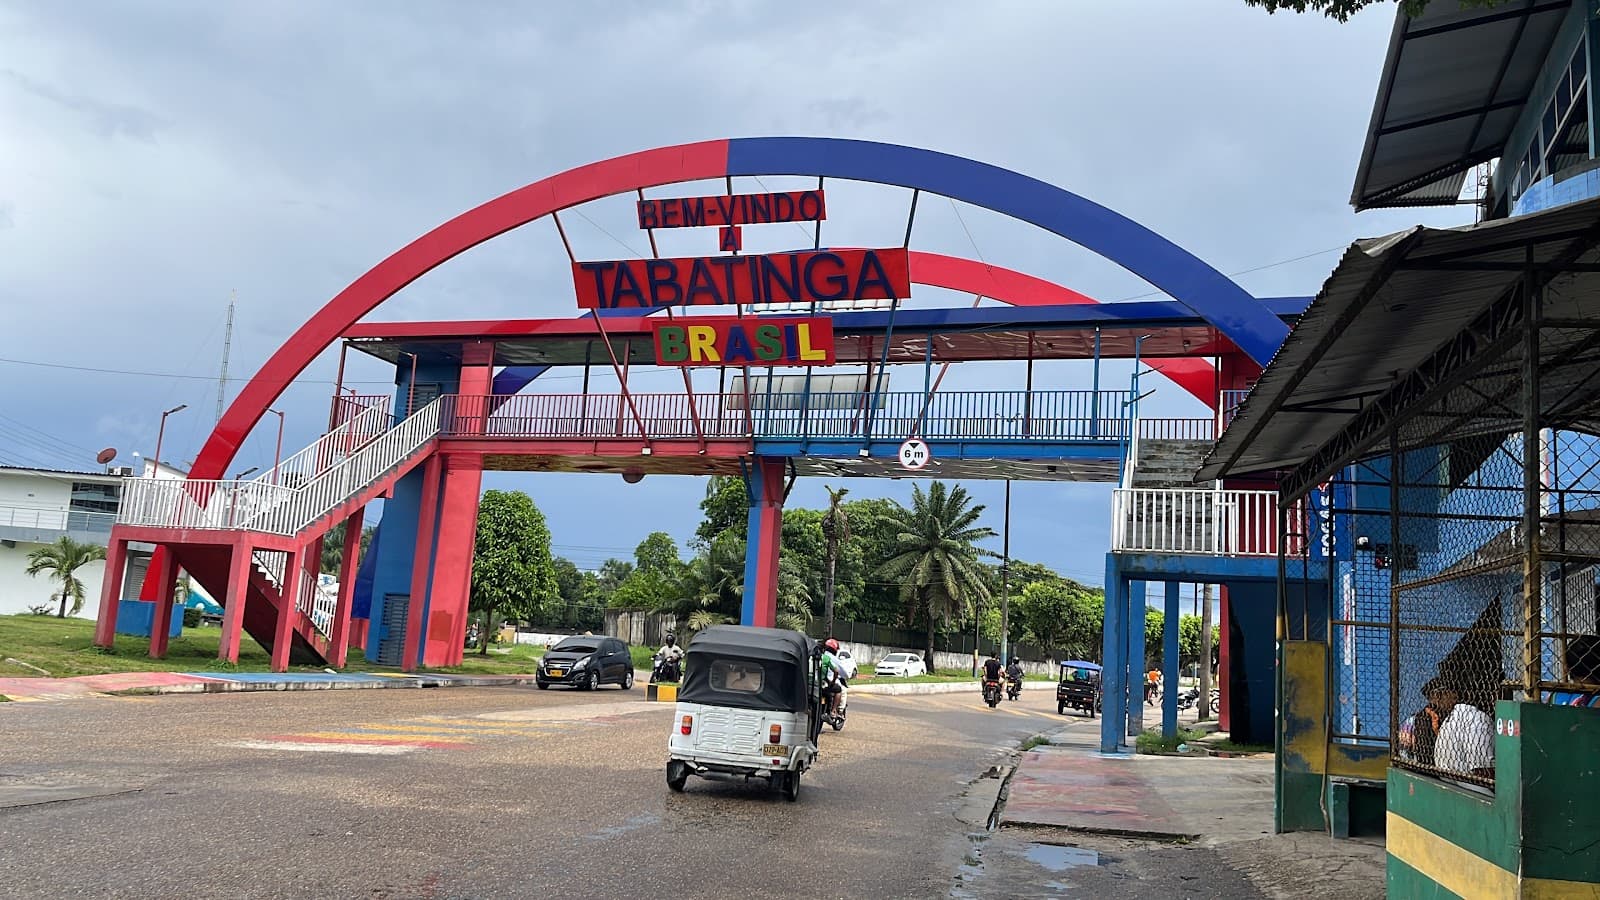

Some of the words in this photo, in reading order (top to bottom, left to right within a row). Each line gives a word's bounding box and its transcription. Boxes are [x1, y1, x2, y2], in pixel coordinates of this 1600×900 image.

[639, 191, 822, 229] BEM-VINDO
[722, 228, 739, 250] A
[580, 251, 896, 308] TABATINGA
[658, 323, 826, 362] BRASIL
[904, 449, 911, 458] 6
[914, 451, 924, 459] m
